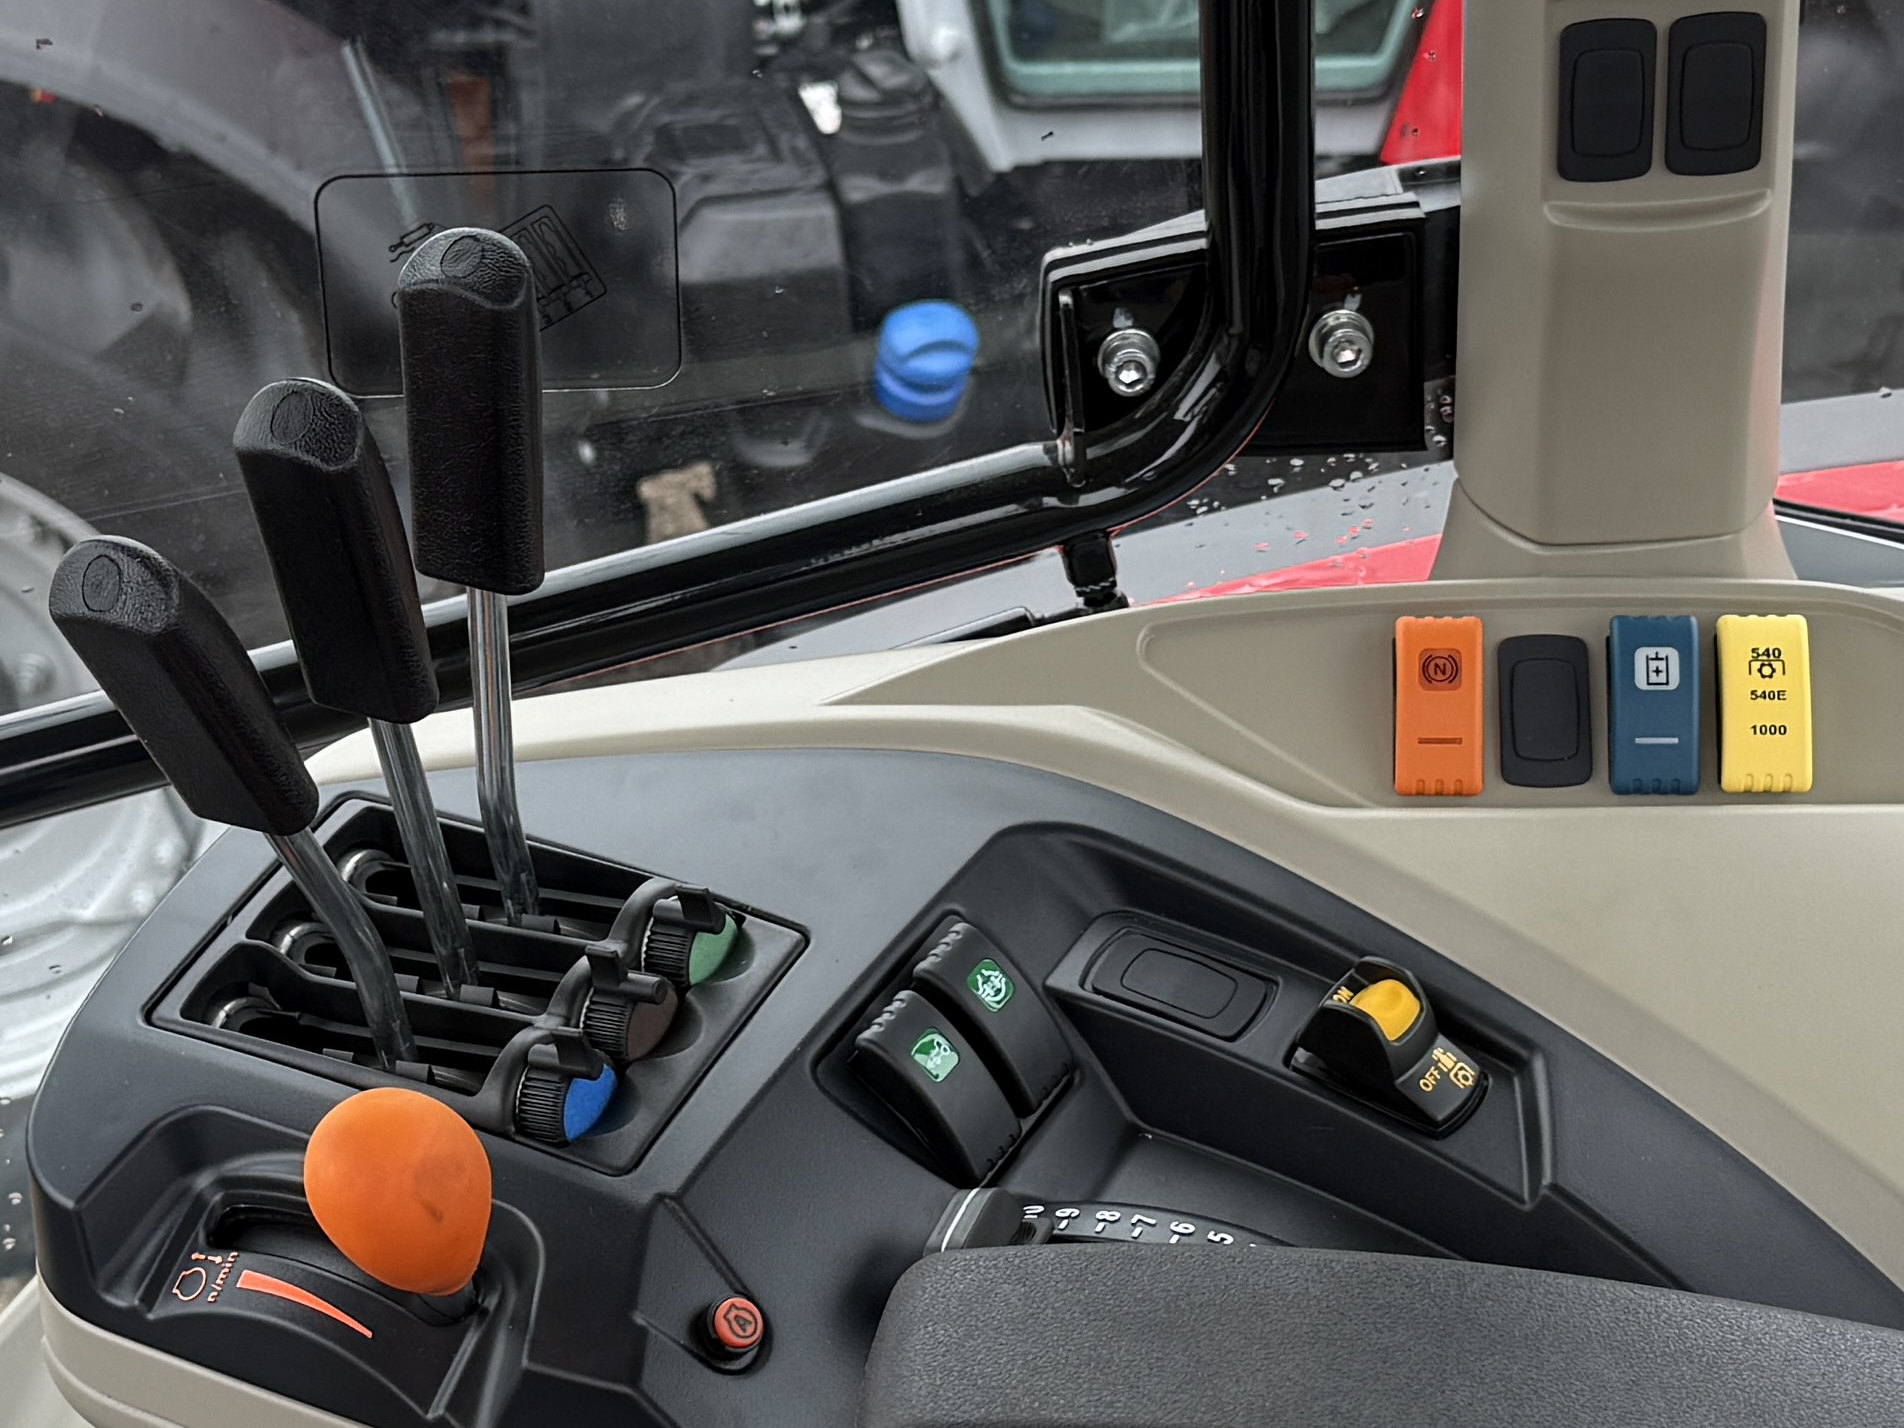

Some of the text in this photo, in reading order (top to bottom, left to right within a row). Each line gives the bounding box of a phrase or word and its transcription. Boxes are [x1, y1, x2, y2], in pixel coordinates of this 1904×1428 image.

[1751, 647, 1782, 659] 540
[1750, 690, 1787, 701] 540E
[1750, 724, 1787, 735] 1000
[1419, 1066, 1441, 1092] OFF
